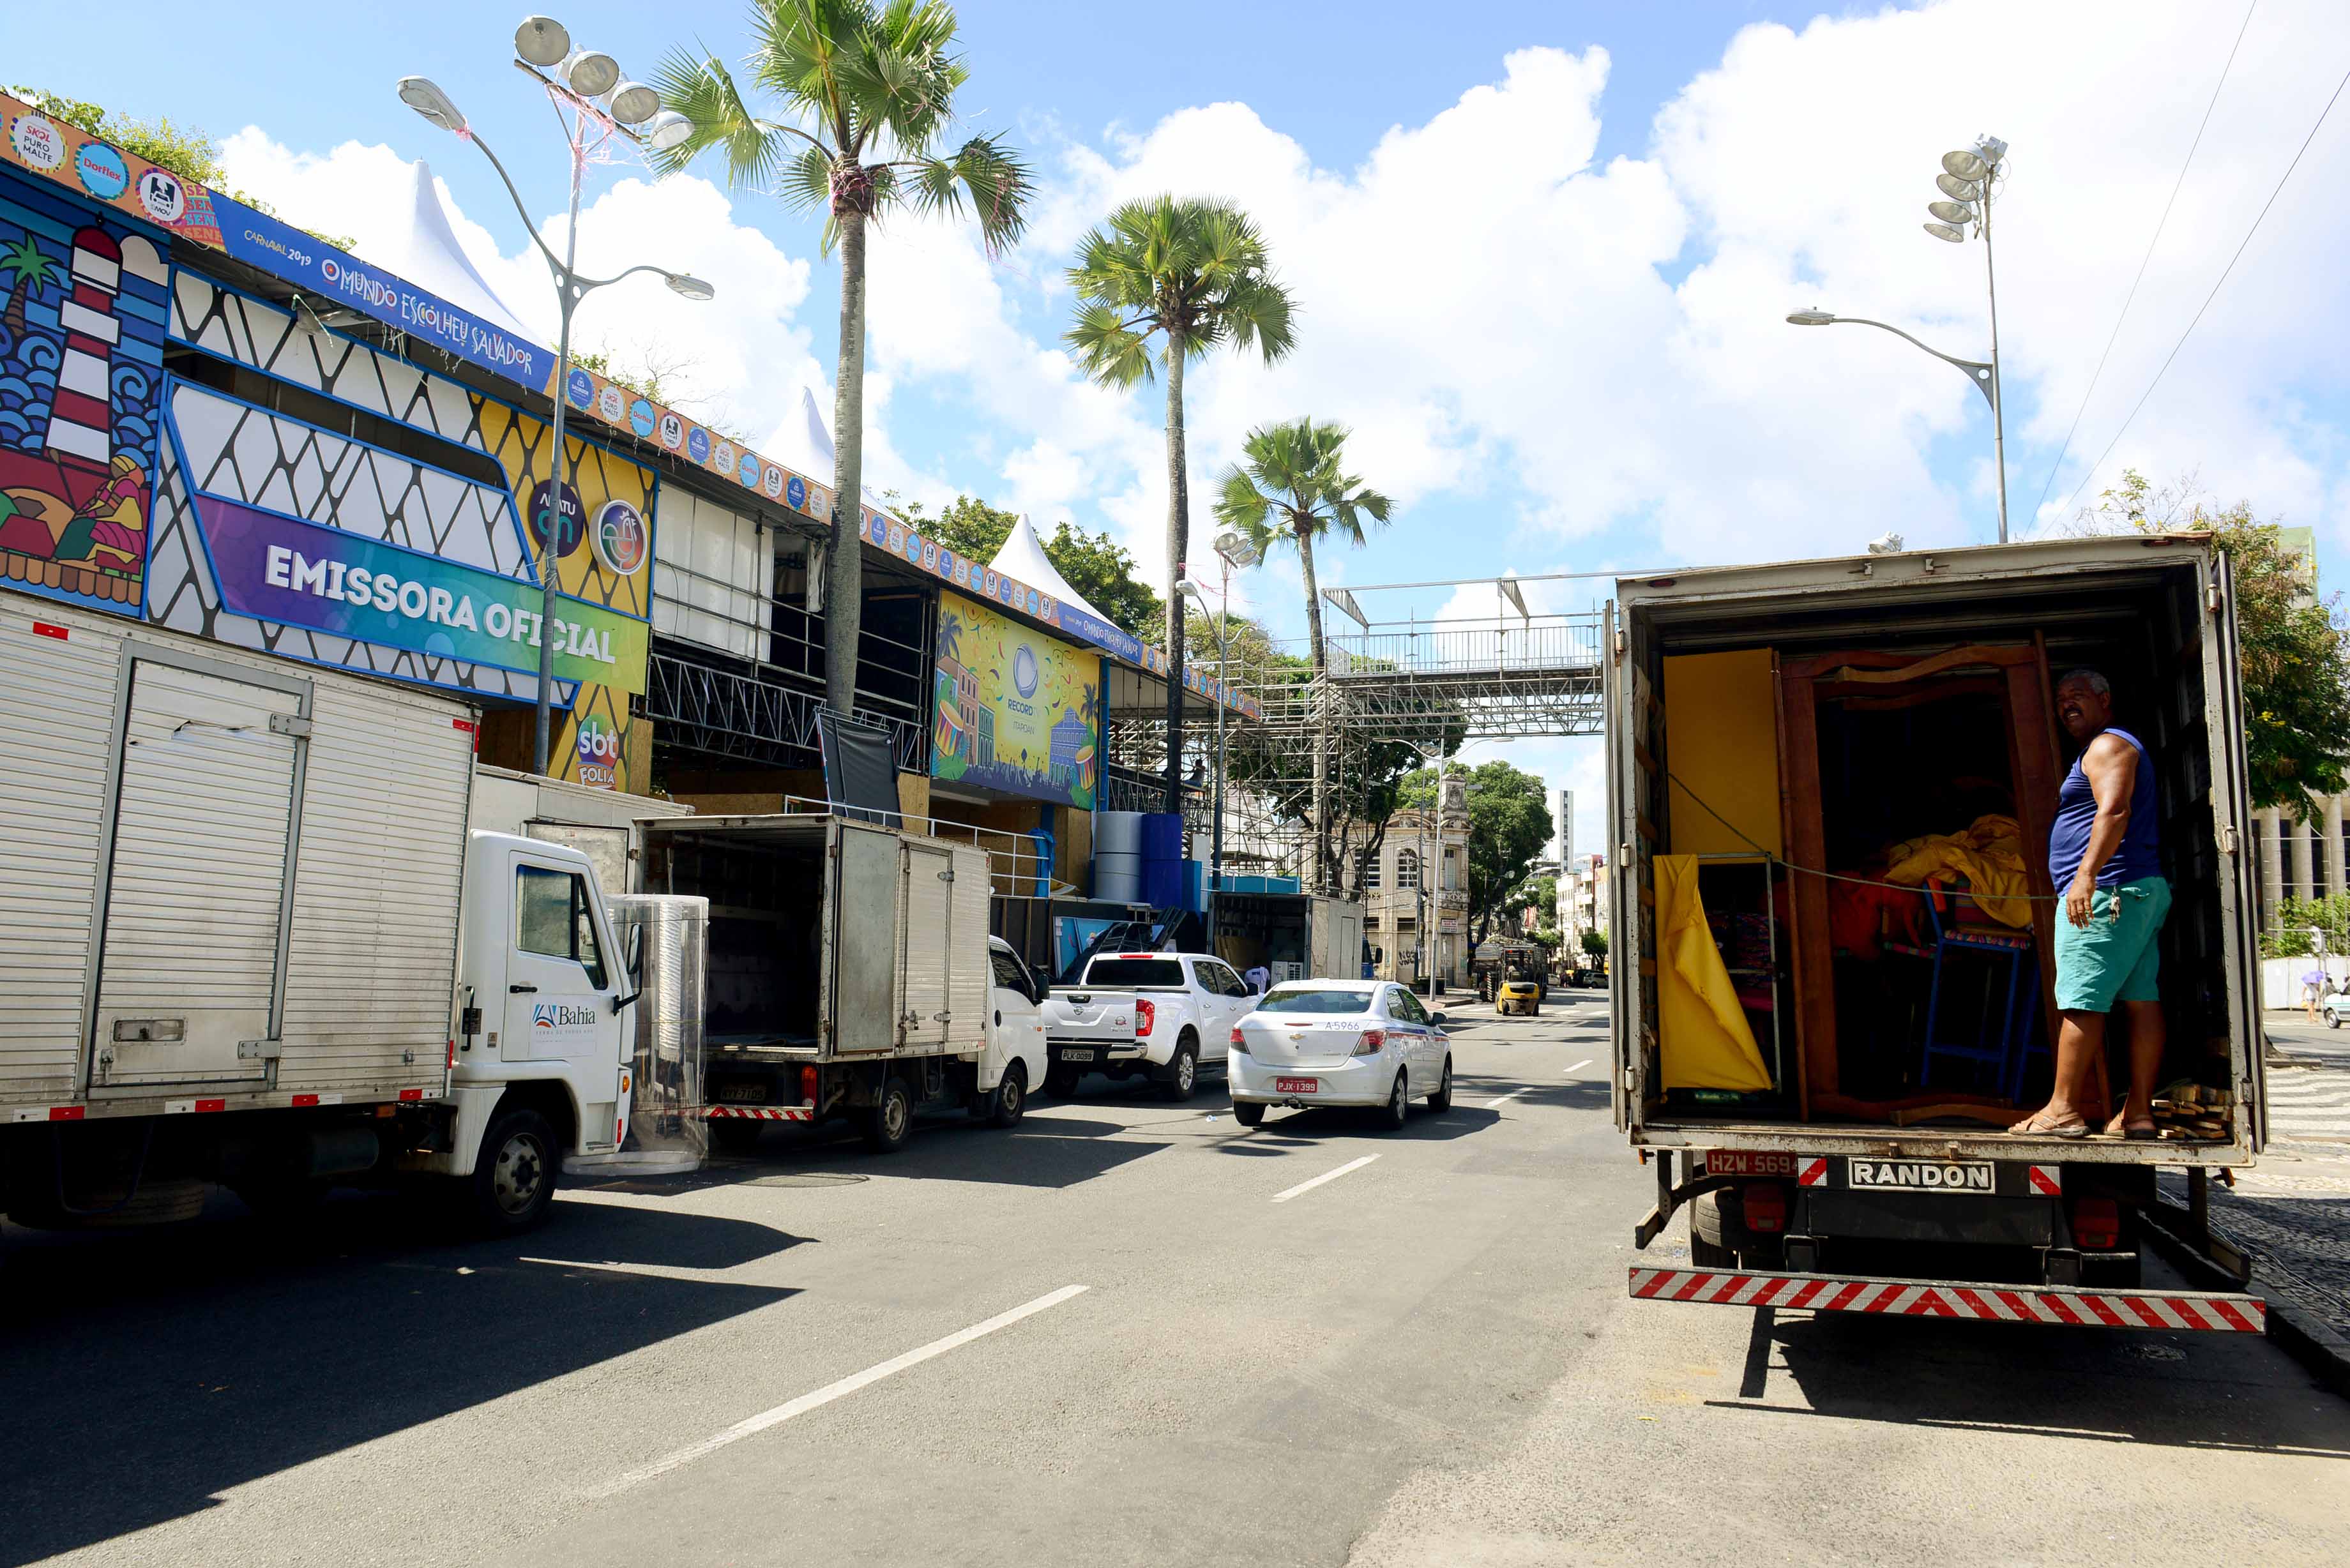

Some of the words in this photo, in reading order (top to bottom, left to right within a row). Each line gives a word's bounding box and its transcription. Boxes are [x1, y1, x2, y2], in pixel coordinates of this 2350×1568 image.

[26, 125, 50, 142] SKOL
[23, 144, 52, 163] MALTE
[24, 135, 50, 153] PURO
[84, 158, 121, 181] Dorflex
[245, 229, 287, 256] CARNAVAL
[287, 249, 312, 266] 2019
[322, 259, 340, 282] O
[340, 265, 397, 308] MUNDO
[401, 292, 468, 347] ESCOLHEU
[471, 326, 532, 375] SALVADOR
[264, 545, 478, 632] EMISSORA
[580, 721, 616, 758] sbt
[580, 766, 615, 786] FOLIA
[559, 1006, 596, 1025] Bahia
[1063, 1052, 1092, 1060] PLK-0099
[1278, 1082, 1315, 1092] PJX-1399
[1854, 1163, 1989, 1188] RANDON
